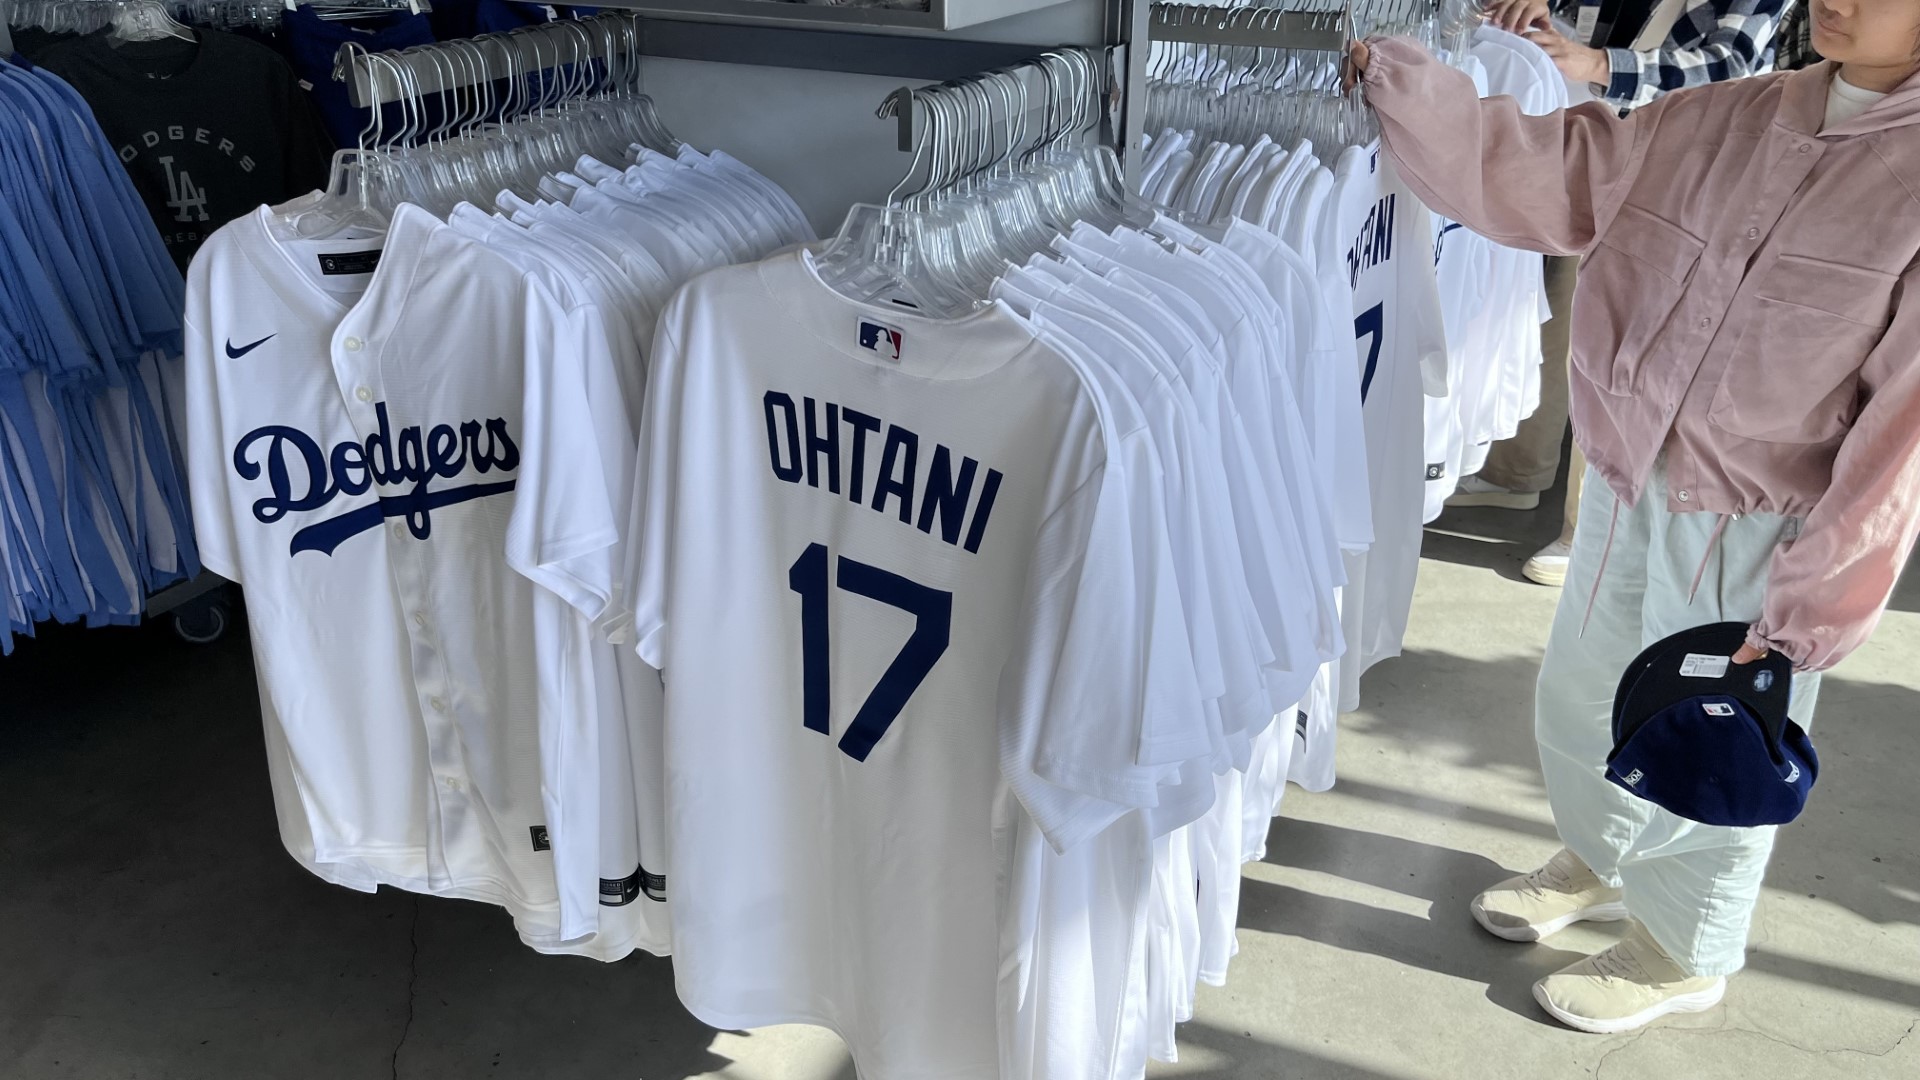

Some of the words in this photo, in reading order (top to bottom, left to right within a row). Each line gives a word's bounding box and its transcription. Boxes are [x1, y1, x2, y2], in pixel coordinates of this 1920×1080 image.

[233, 401, 521, 540] Dodgers
[763, 389, 1004, 555] OHTANI
[788, 541, 953, 763] 17
